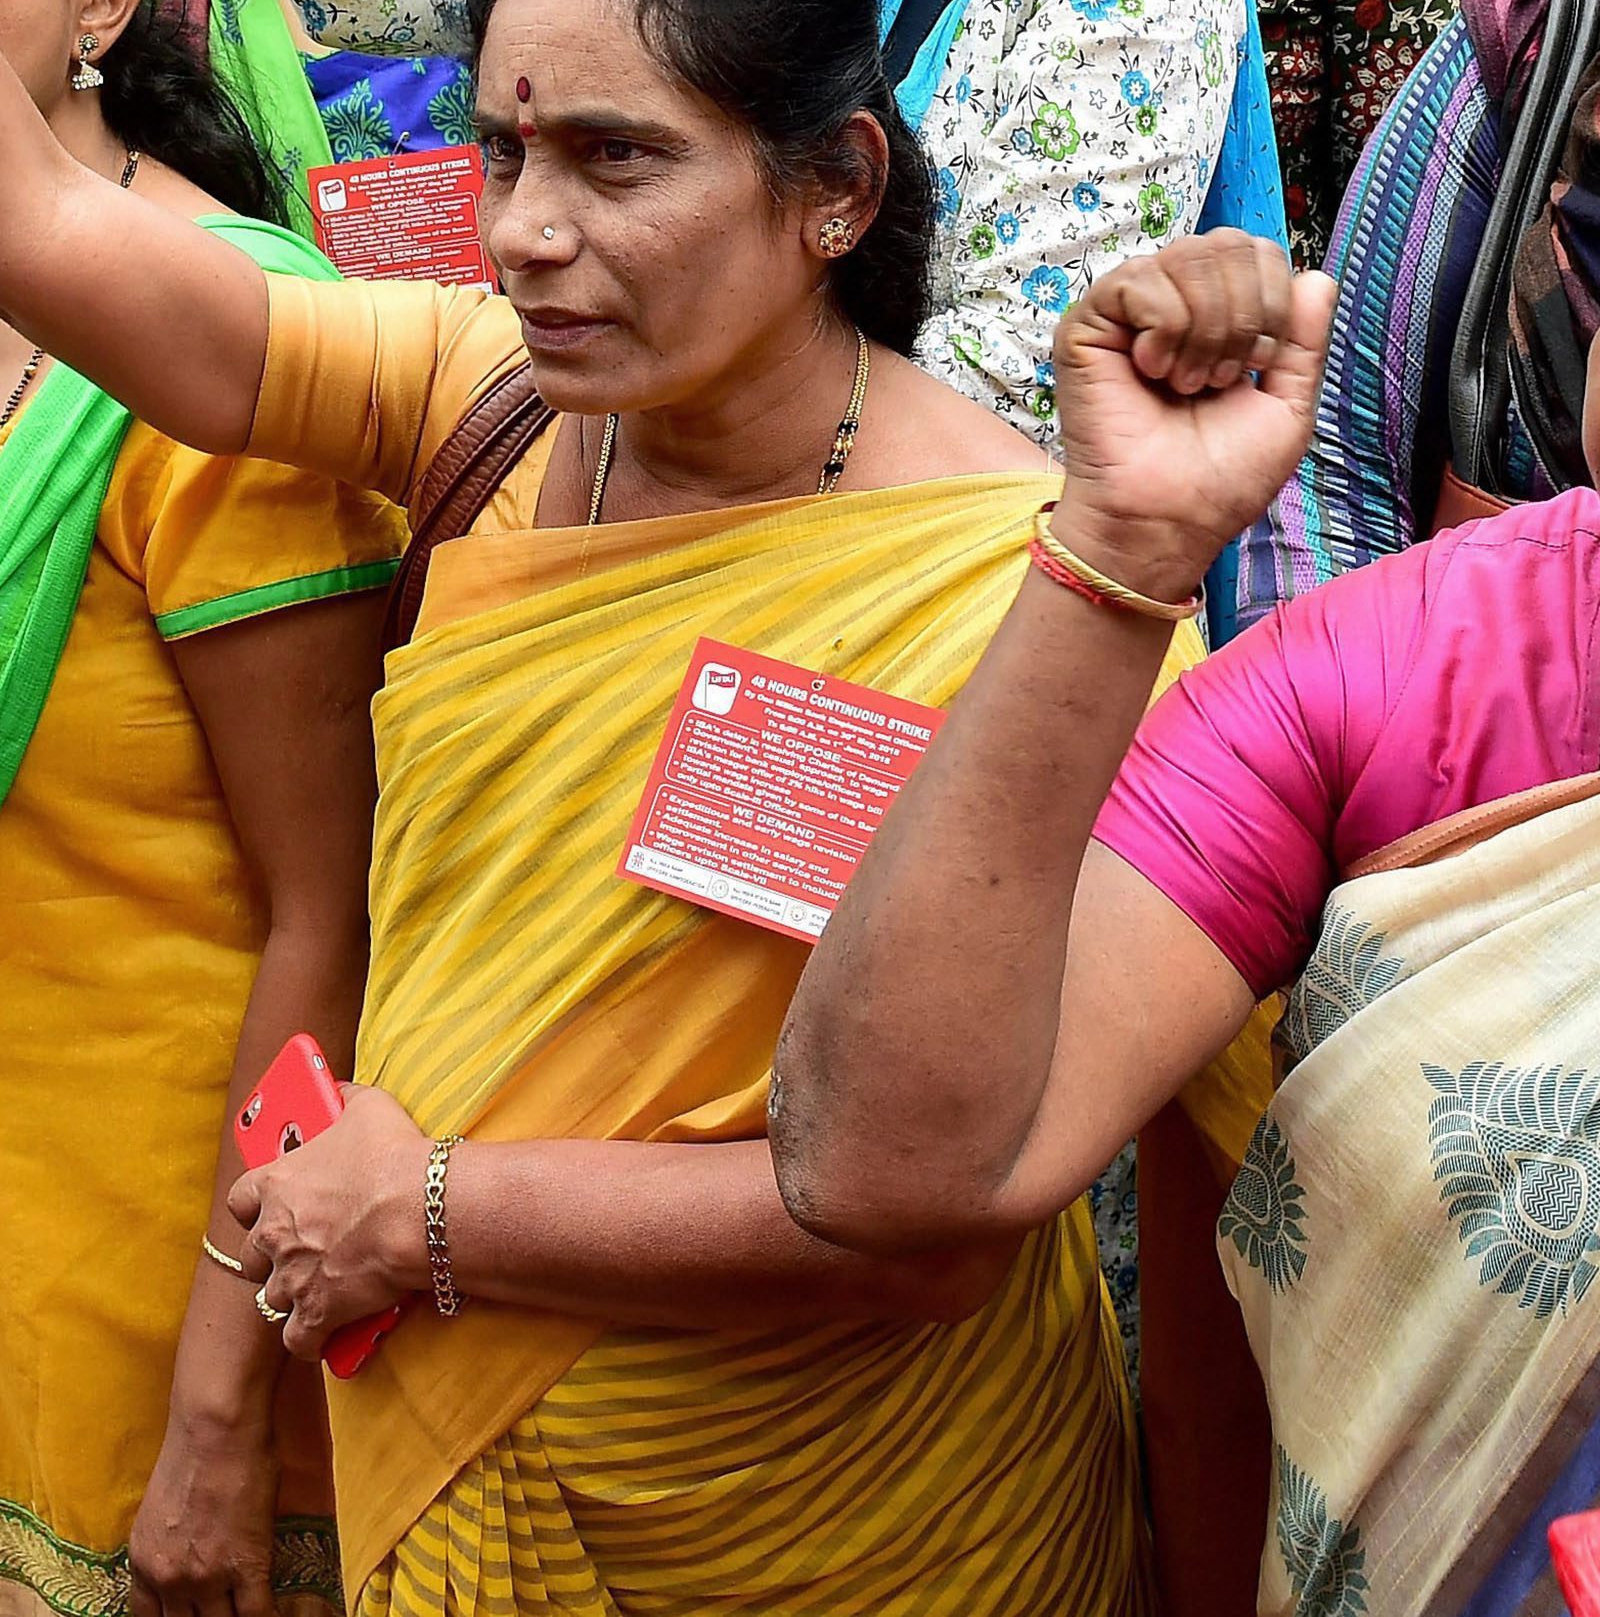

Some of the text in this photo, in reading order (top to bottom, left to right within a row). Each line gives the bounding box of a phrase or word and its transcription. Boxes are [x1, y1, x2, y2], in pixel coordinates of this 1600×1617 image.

[751, 675, 931, 740] 48 HOURS CONTINUOUS STRIKE
[729, 749, 743, 759] for
[761, 729, 841, 763] WE OPPOSE
[723, 768, 748, 781] wage
[808, 756, 844, 773] Charter
[846, 770, 857, 778] of
[775, 775, 786, 783] of
[827, 791, 837, 800] in
[839, 796, 864, 809] wage
[849, 779, 859, 787] to
[862, 784, 887, 797] wage
[733, 804, 815, 839] WE DEMAND
[783, 796, 797, 807] by
[798, 802, 825, 815] some
[839, 815, 855, 826] the
[662, 812, 829, 874] Adequate increase in salary and
[669, 794, 856, 863] Expeditious and early wage revision
[729, 845, 739, 854] in
[741, 851, 770, 864] other
[788, 877, 799, 886] to
